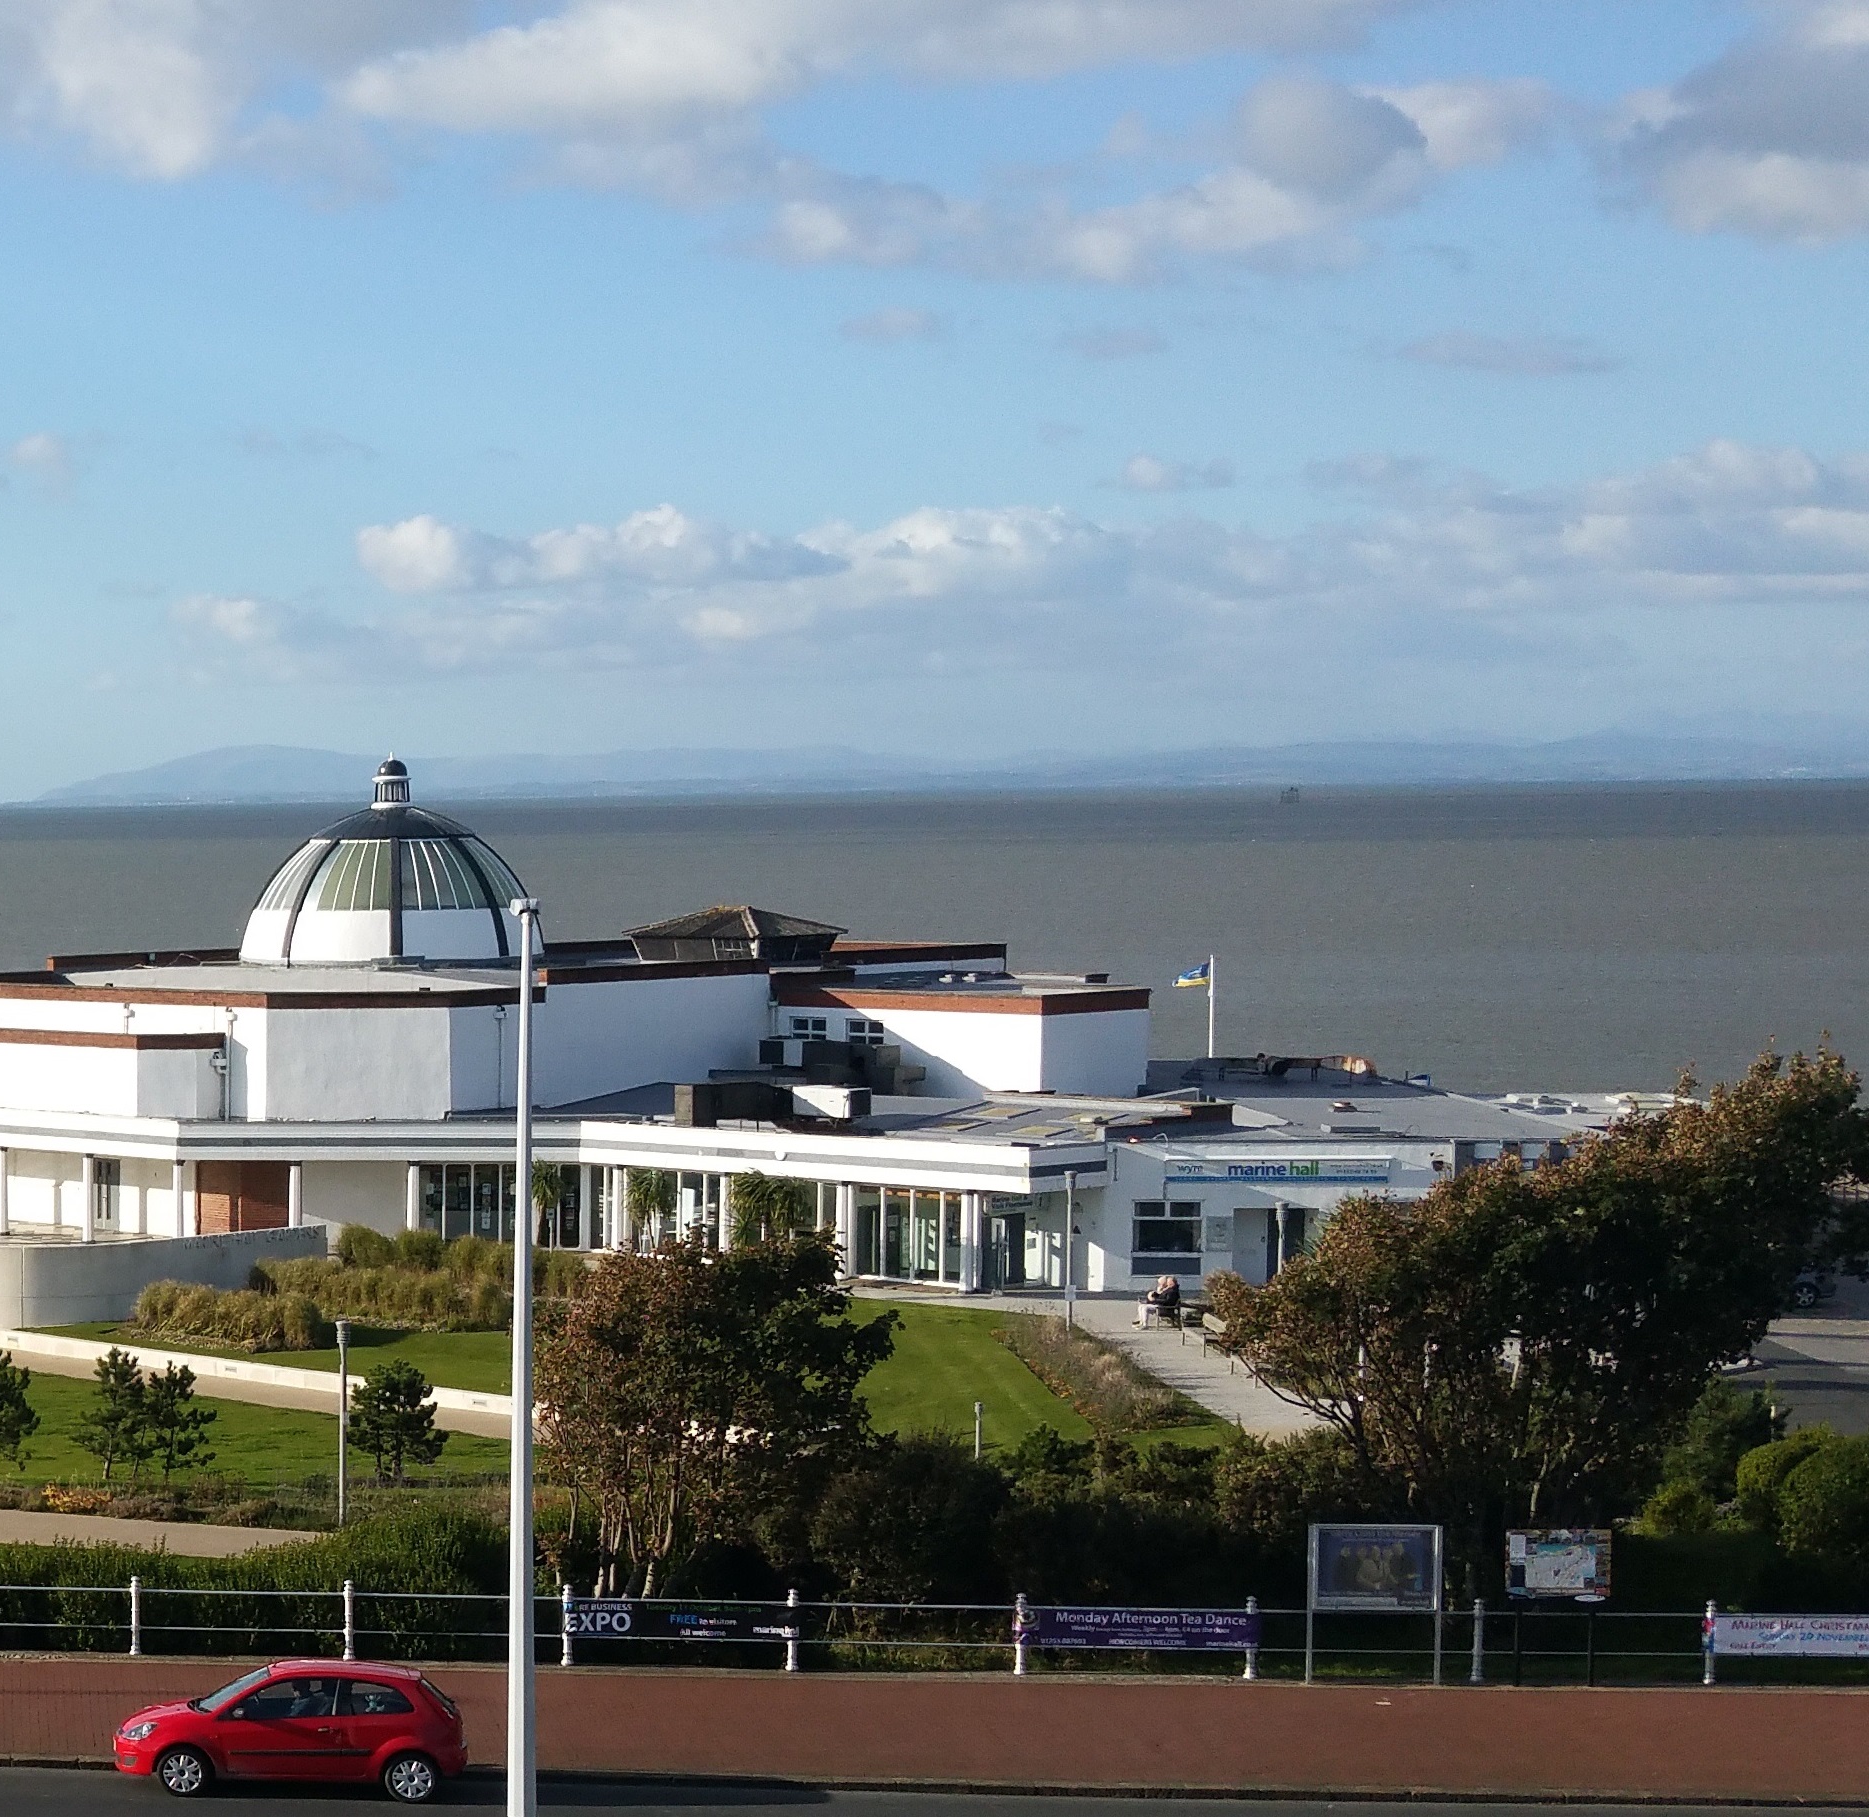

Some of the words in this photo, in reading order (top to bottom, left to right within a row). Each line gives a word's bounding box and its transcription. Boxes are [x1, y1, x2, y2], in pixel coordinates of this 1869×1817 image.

[1227, 1161, 1286, 1176] marine
[1289, 1160, 1319, 1176] hall
[591, 1603, 633, 1611] BUSINESS
[565, 1612, 632, 1632] EXPO
[669, 1614, 698, 1625] FREE
[1055, 1611, 1109, 1626] Monday
[1112, 1612, 1178, 1625] Afternoon
[1180, 1613, 1202, 1625] Tea
[1205, 1613, 1247, 1626] Dance
[1731, 1620, 1776, 1630] MARINE
[1780, 1620, 1804, 1630] HALL
